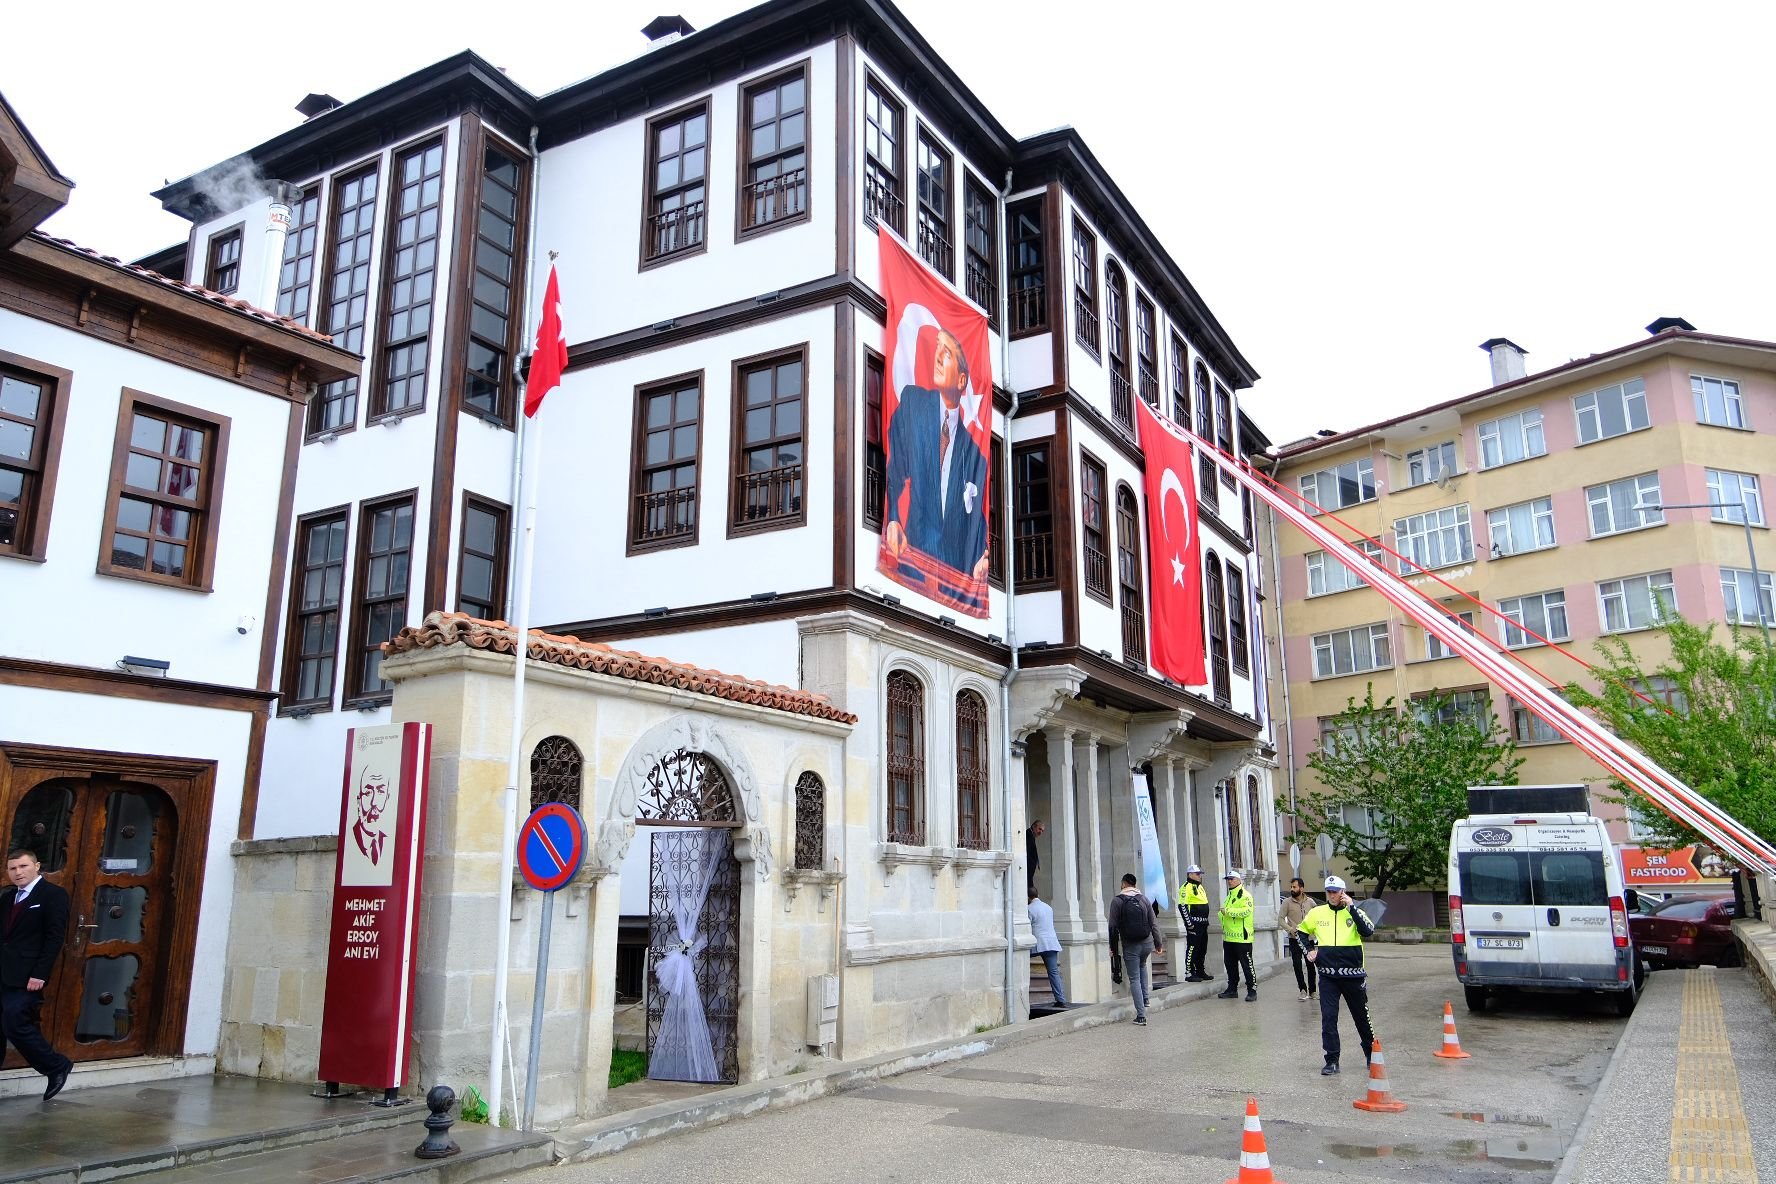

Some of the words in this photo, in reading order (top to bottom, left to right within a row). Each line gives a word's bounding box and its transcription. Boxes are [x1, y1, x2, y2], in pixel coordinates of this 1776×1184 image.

[1646, 855, 1667, 866] ŞEN
[1630, 867, 1687, 877] FASTFOOD
[345, 898, 386, 911] MEHMET
[352, 911, 376, 927] AKİF
[347, 930, 379, 943] ERSOY
[1482, 939, 1491, 947] 37
[343, 946, 362, 959] ANI
[363, 944, 380, 960] EVİ
